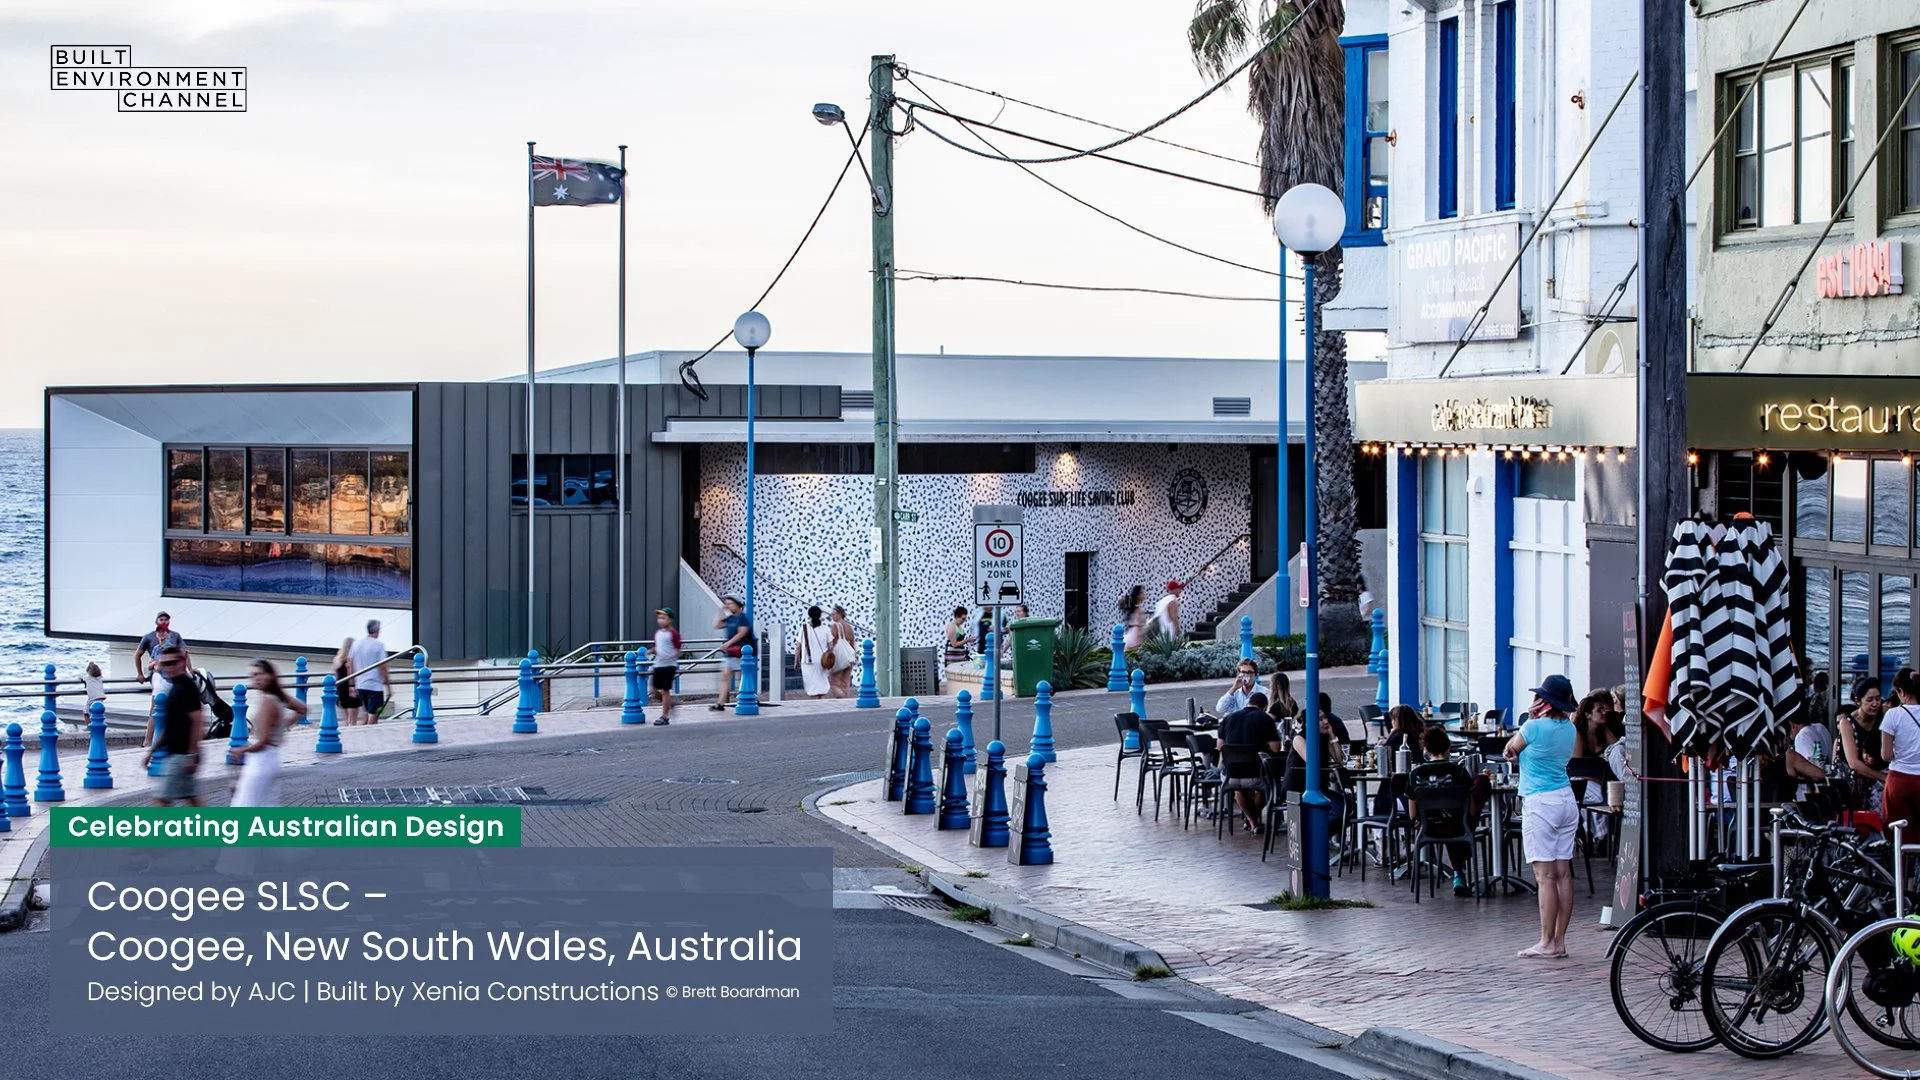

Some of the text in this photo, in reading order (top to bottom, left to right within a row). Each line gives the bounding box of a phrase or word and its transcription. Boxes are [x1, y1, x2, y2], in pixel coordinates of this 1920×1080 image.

[1407, 233, 1507, 270] GRAND PACIFIC
[1459, 266, 1485, 292] Beach
[1421, 300, 1488, 319] ACCOMMODATI
[1017, 490, 1135, 507] COOGEE SURF LIFE SAVING CLUB
[993, 537, 1006, 549] 10
[981, 560, 1018, 568] SHARED
[987, 570, 1012, 578] ZONE
